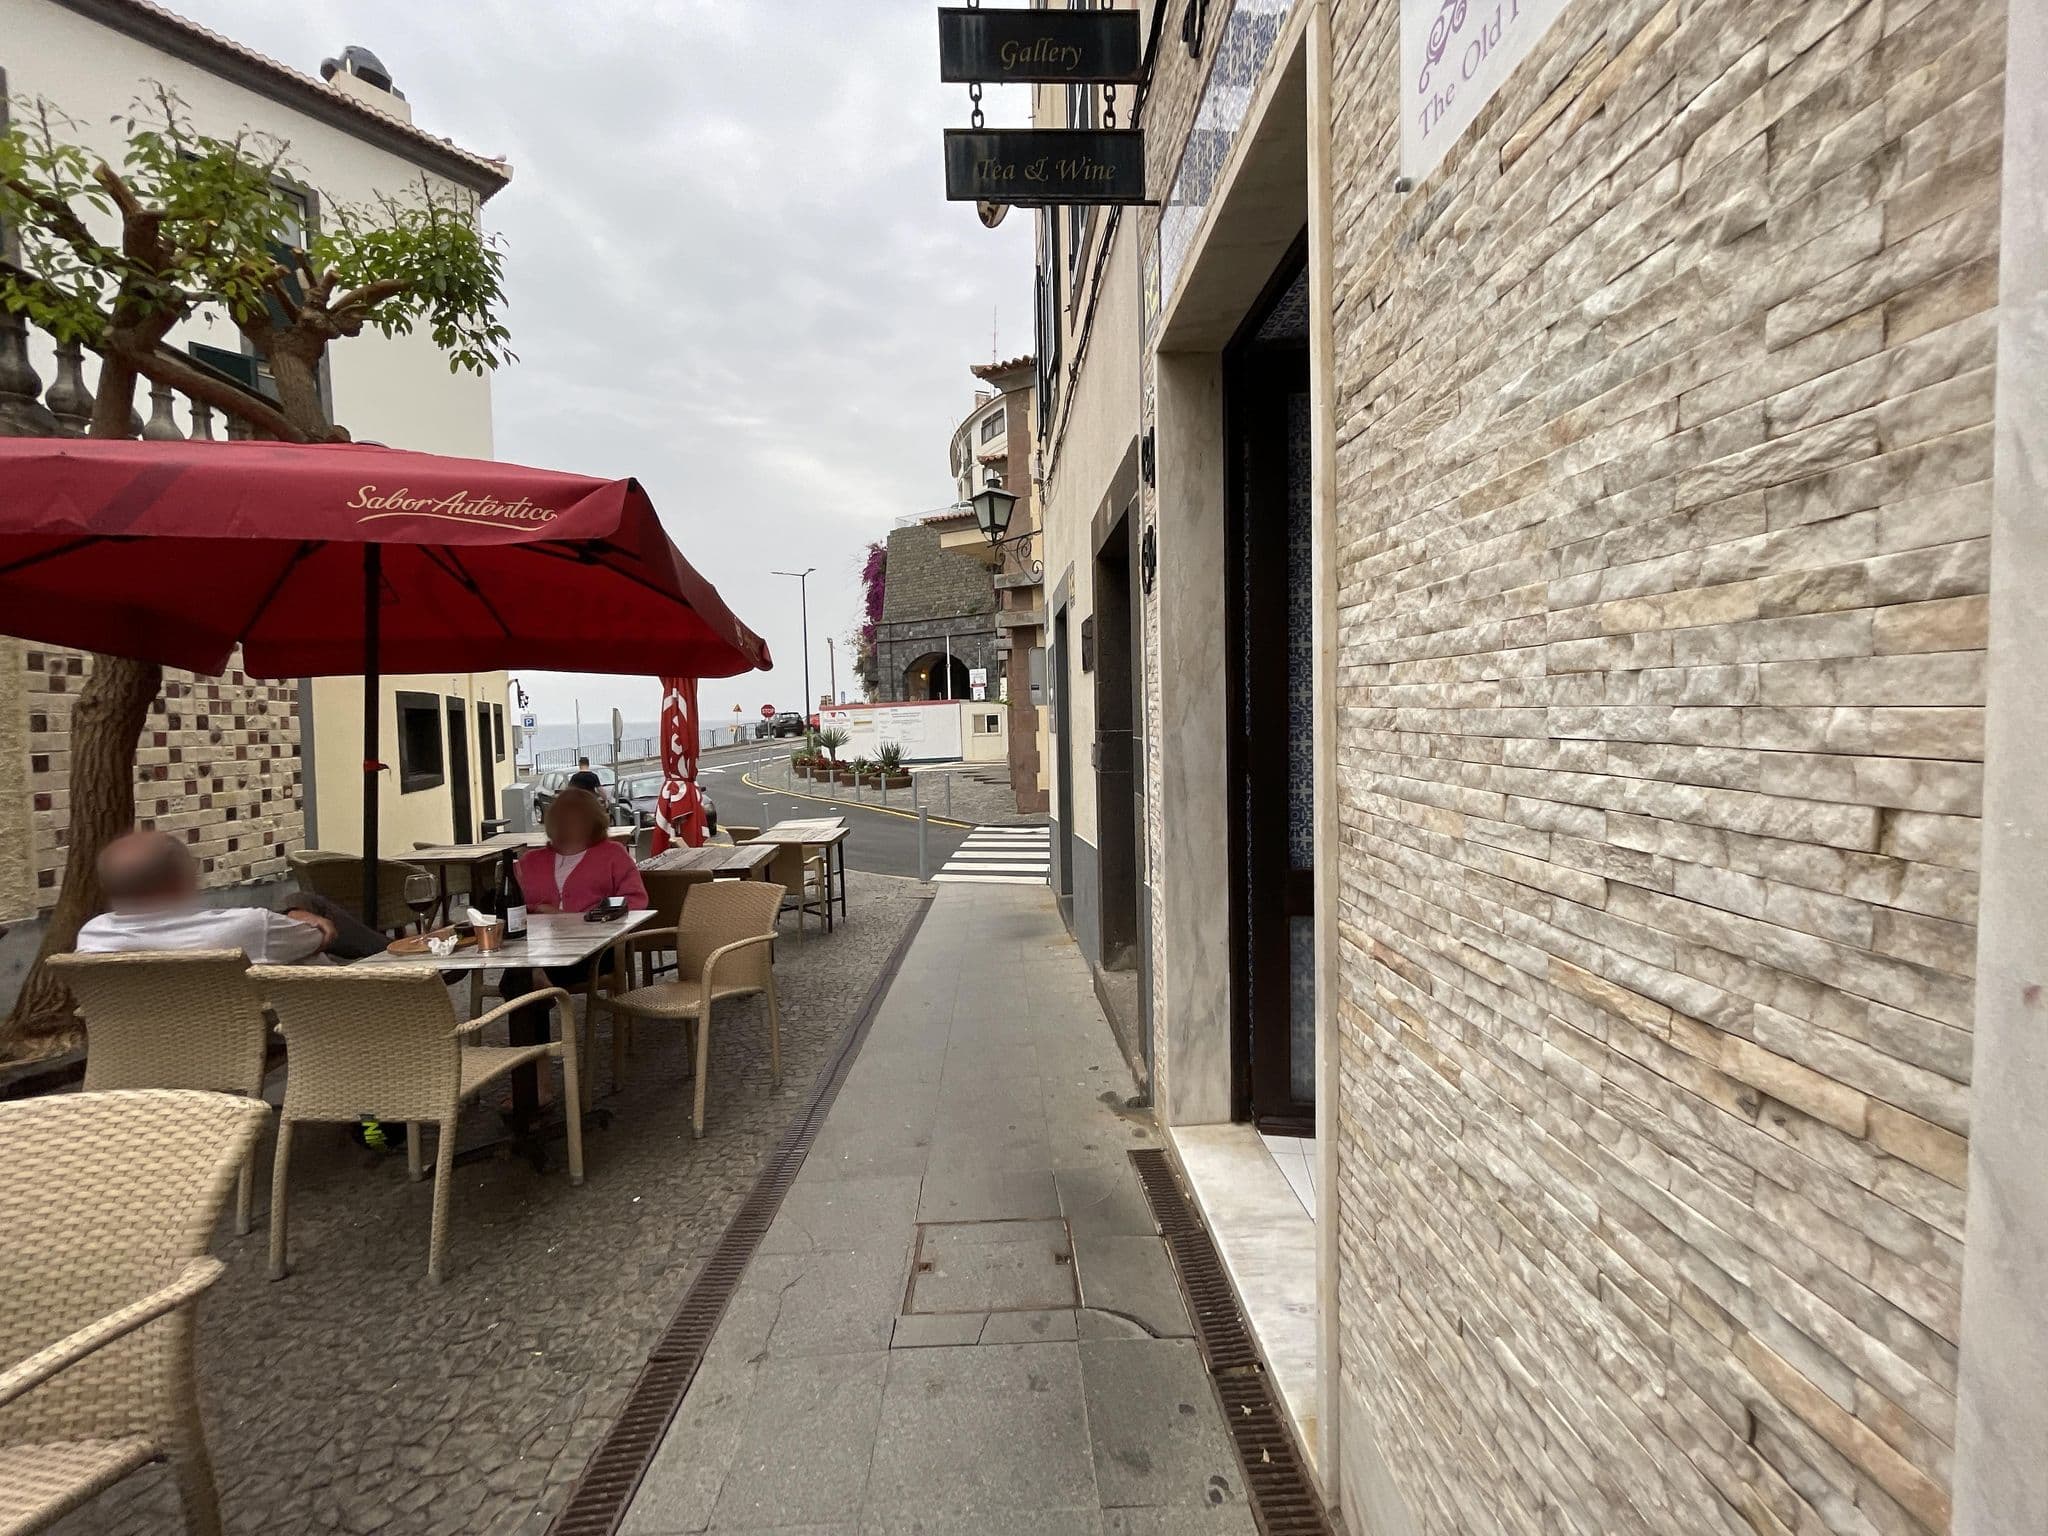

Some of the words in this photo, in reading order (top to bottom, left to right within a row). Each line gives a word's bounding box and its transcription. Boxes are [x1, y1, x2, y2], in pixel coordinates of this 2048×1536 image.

[1000, 38, 1082, 71] Gallery
[1418, 83, 1455, 140] The
[1462, 3, 1501, 80] Old
[978, 158, 1016, 181] Tea
[1024, 156, 1049, 182] &
[1055, 156, 1117, 181] Wine
[347, 485, 433, 511] Sabor
